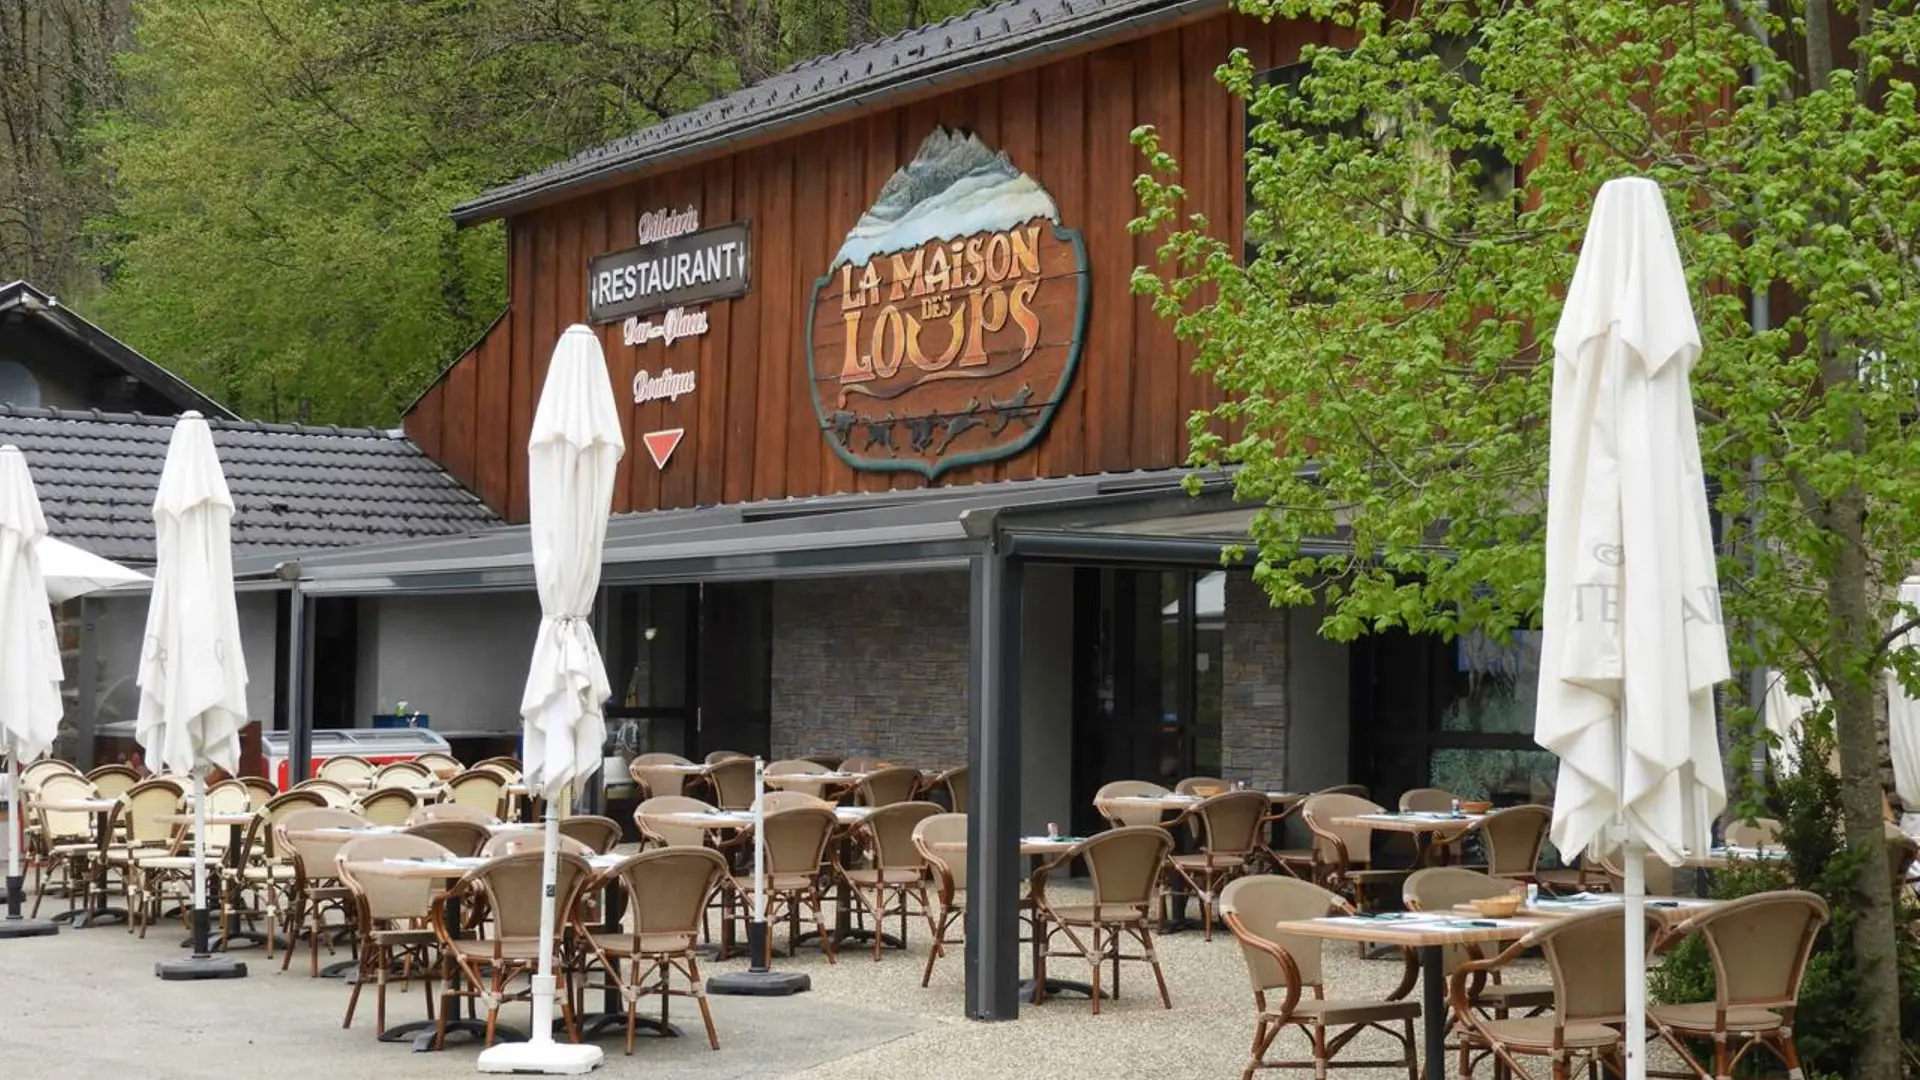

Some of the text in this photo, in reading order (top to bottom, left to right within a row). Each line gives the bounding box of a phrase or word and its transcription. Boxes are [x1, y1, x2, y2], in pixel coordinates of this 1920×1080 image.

[599, 242, 736, 305] RESTAURANT
[841, 261, 883, 311] LA
[840, 278, 1042, 384] LOUPS
[921, 294, 952, 320] DES
[633, 367, 696, 404] Boutique
